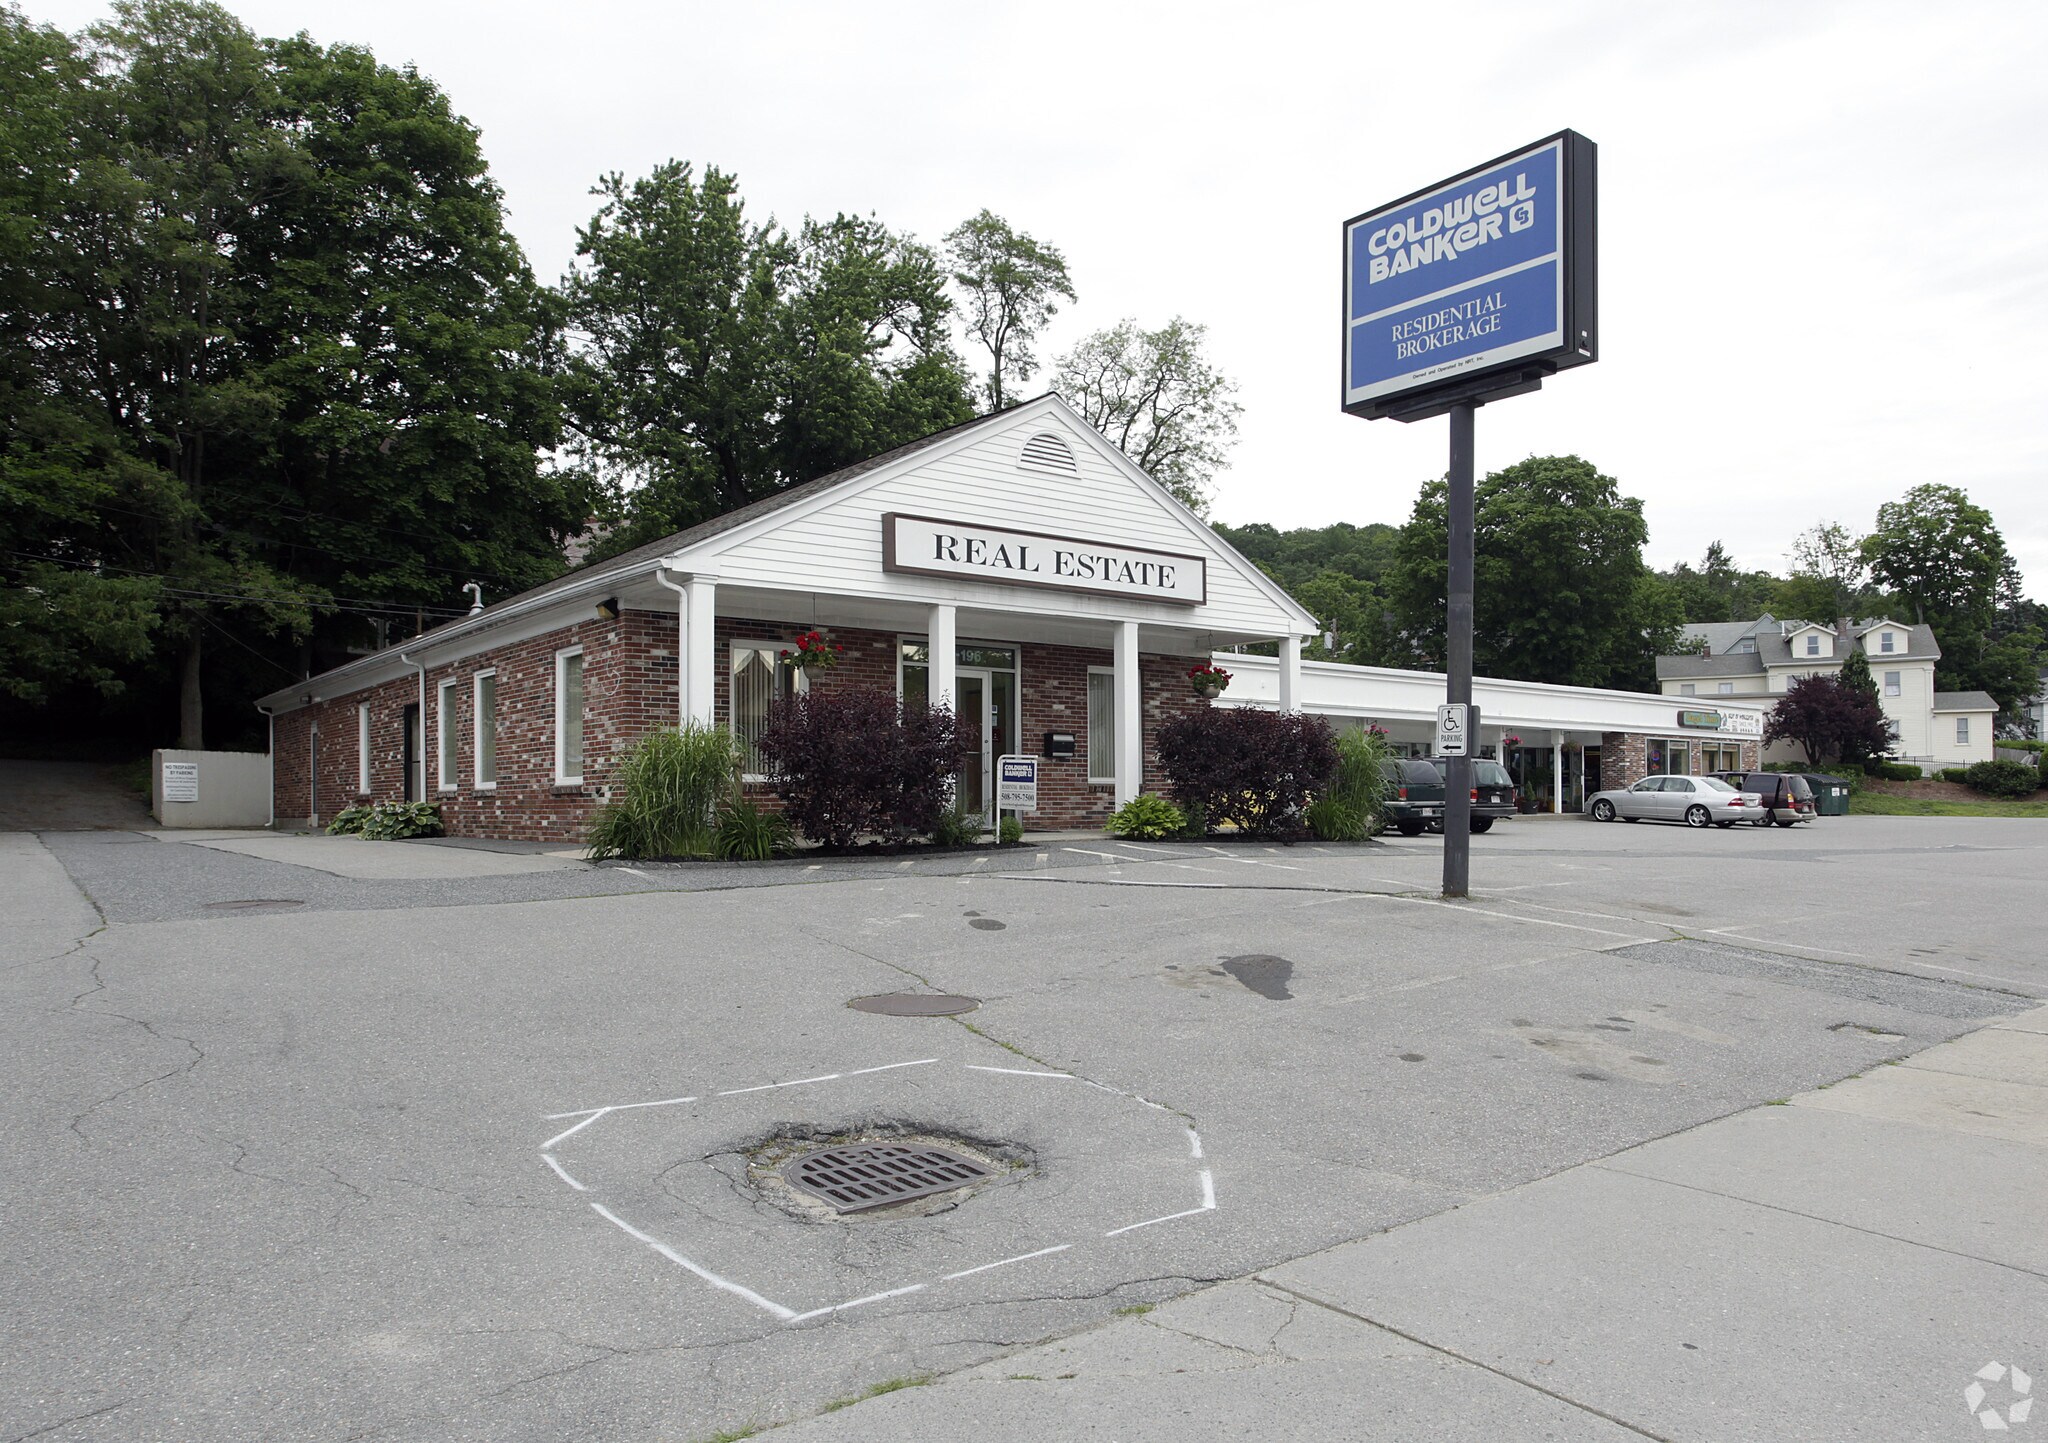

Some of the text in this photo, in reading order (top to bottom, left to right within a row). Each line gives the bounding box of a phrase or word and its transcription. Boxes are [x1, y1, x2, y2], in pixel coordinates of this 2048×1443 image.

[1392, 292, 1506, 342] RESIDENTIAL
[1397, 313, 1501, 360] BROKERAGE
[1437, 363, 1456, 372] Operated
[933, 533, 1176, 589] REAL ESTATE
[1441, 734, 1463, 742] PARKING
[1001, 793, 1034, 801] 508-795-7500
